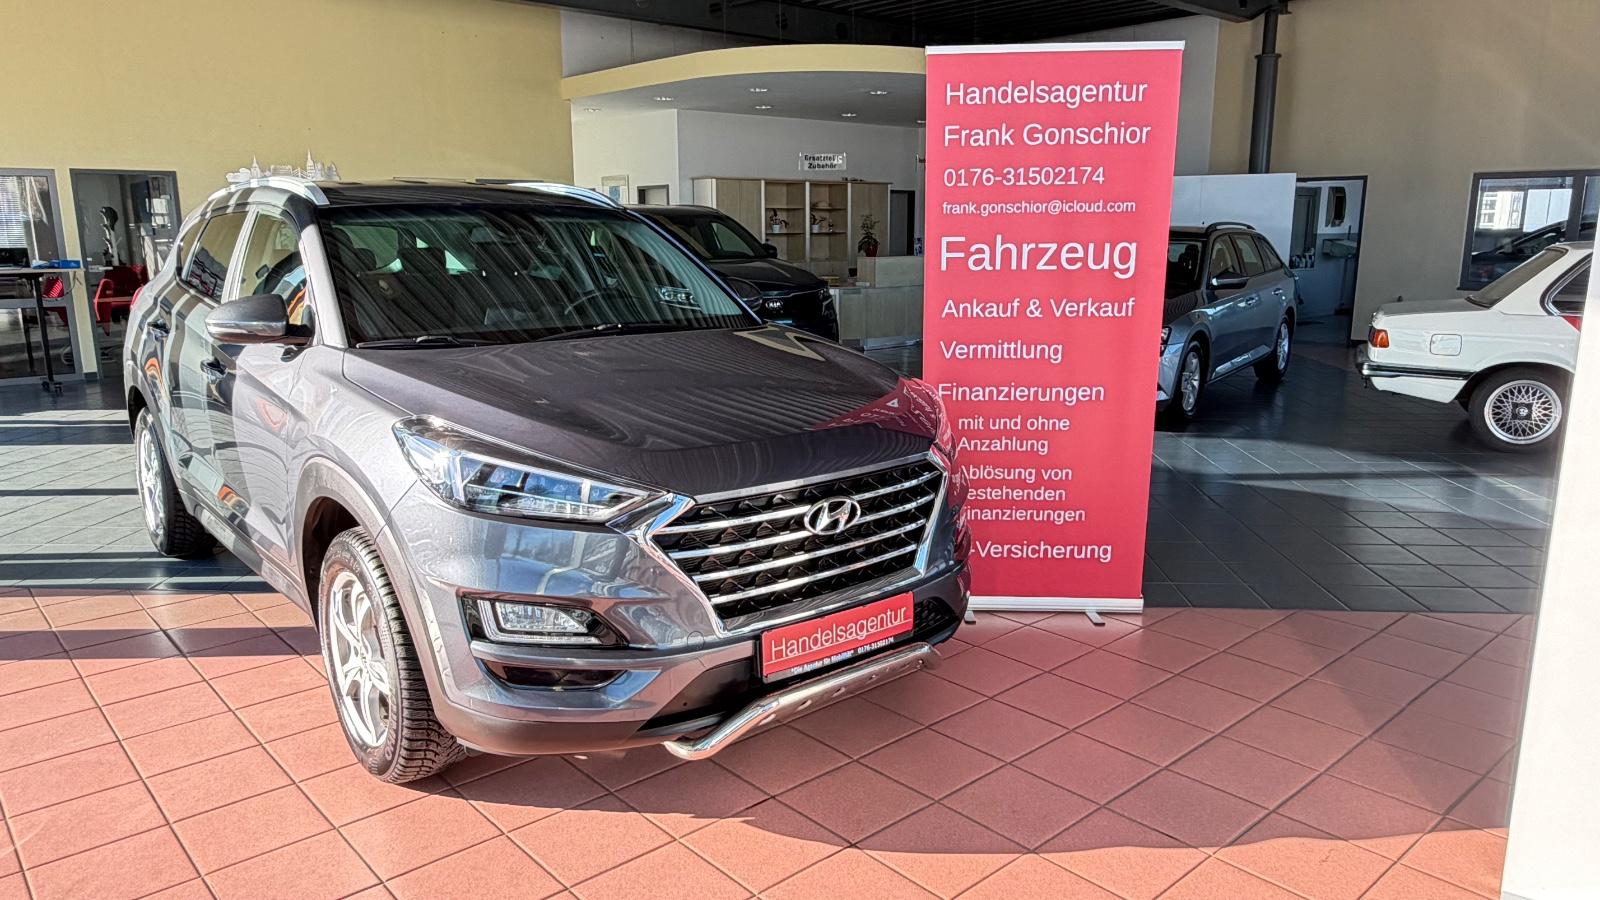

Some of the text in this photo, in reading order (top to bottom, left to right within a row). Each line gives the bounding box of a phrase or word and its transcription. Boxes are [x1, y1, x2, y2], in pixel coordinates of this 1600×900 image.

[946, 80, 1148, 109] Handelsagentur
[944, 122, 1151, 147] Frank Gonschior
[943, 166, 1105, 187] 0176-31502174
[942, 200, 1136, 217] frank.gonschior@icloud.com
[940, 234, 1137, 279] Fahrzeug
[941, 298, 1136, 318] Ankauf & Verkauf
[940, 340, 1063, 364] Vermittlung
[938, 382, 1105, 405] Finanzierungen
[958, 415, 1070, 431] mit und ohne
[957, 436, 1049, 455] Anzahlung
[1041, 467, 1072, 481] von
[967, 486, 1066, 501] estehenden
[964, 506, 1086, 525] inanzierungen
[771, 606, 906, 661] Handelsagentur
